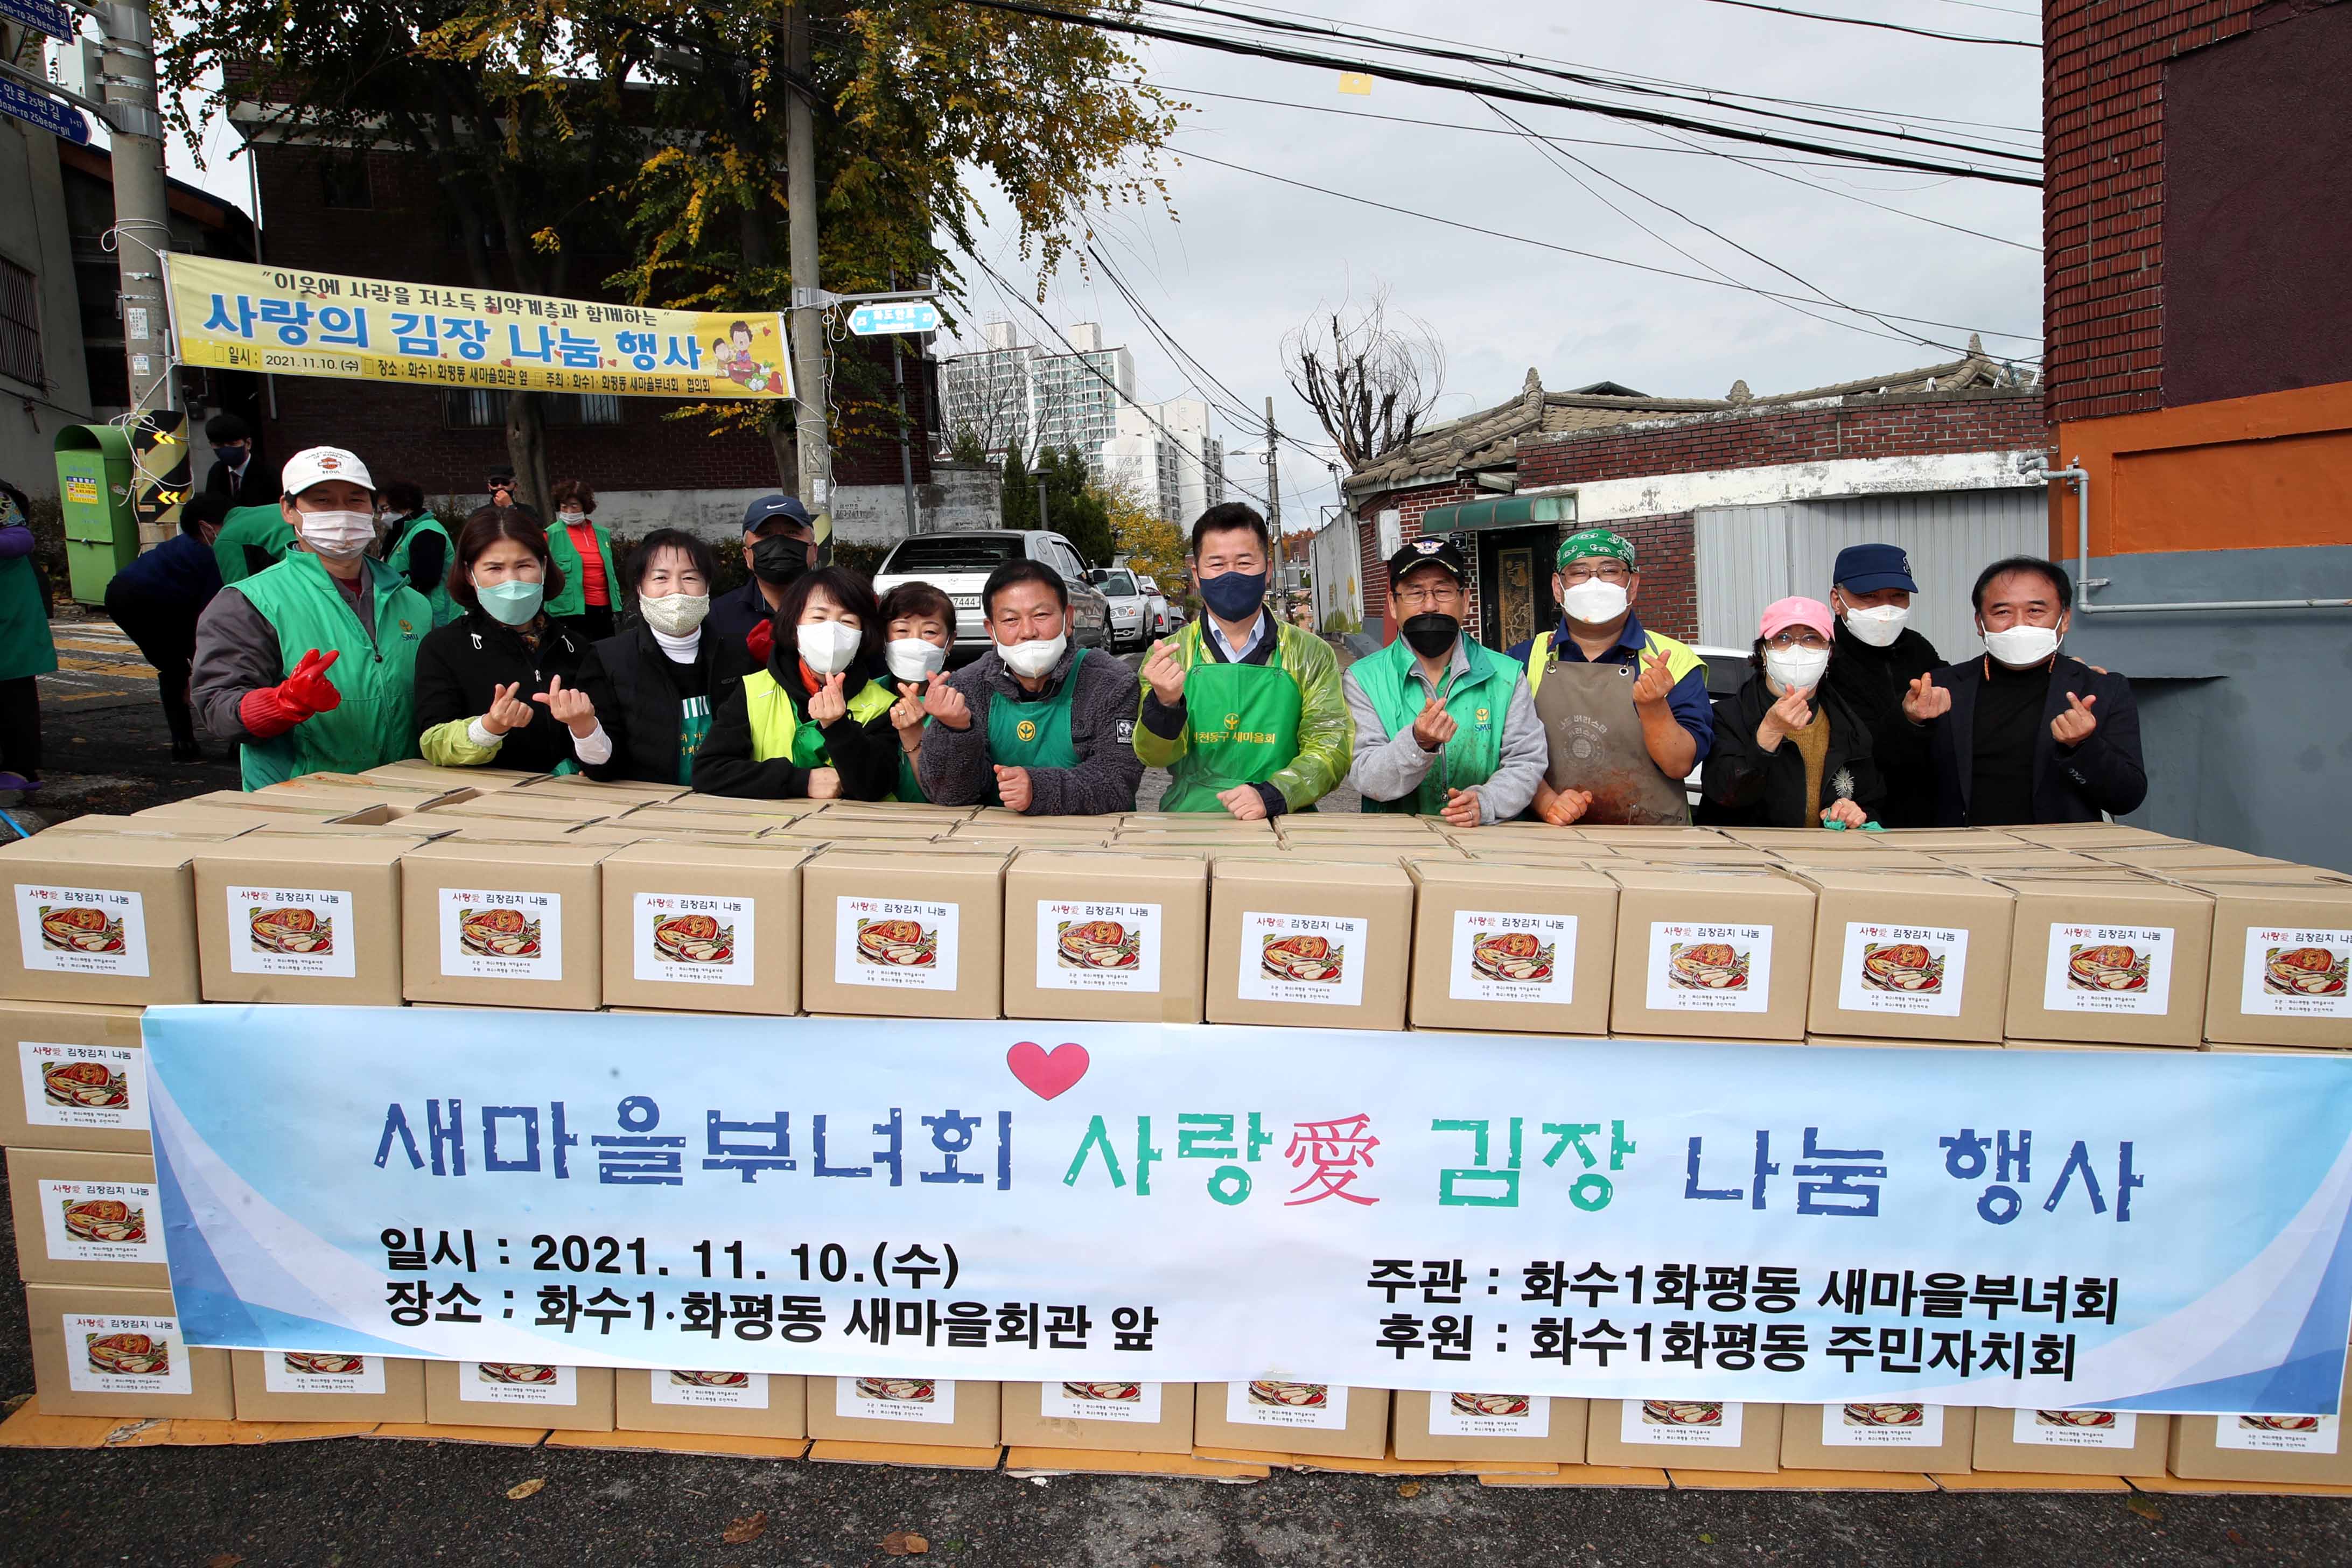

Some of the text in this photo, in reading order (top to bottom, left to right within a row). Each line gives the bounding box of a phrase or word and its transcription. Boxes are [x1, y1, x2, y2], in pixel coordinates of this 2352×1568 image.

[27, 12, 70, 39] 26beon-gil
[0, 83, 60, 121] 안로25번길
[31, 111, 70, 136] 25beon-gil
[350, 282, 411, 305] 사랑을
[418, 289, 476, 311] 저소득
[485, 296, 579, 319] 취약계층과
[586, 305, 656, 326] 함께하는
[204, 293, 702, 371] 사랑의 김장 나눔 행사
[229, 346, 250, 366] 일시
[379, 360, 397, 376] 장소
[470, 367, 515, 386] 새마을회관
[520, 370, 528, 386] 옆
[547, 373, 563, 388] 주최
[954, 598, 975, 606] 7444
[1475, 724, 1491, 732] SMU
[1233, 732, 1276, 745] 새마을회
[65, 892, 103, 903] 김장김치
[110, 895, 129, 904] 나눔
[276, 892, 314, 902] 김장김치
[320, 894, 339, 904] 나눔
[486, 894, 523, 905] 김장김치
[530, 896, 547, 905] 나눔
[681, 900, 717, 910] 김장김치
[724, 902, 741, 911] 나눔
[885, 904, 921, 914] 김장김치
[928, 907, 946, 916] 나눔
[1086, 906, 1123, 916] 김장김치
[1130, 908, 1148, 916] 나눔
[1291, 919, 1329, 930] 김장김치
[1335, 922, 1354, 932] 나눔
[1502, 918, 1539, 928] 김장김치
[1546, 920, 1564, 929] 나눔
[1698, 928, 1735, 937] 김장김치
[1741, 929, 1759, 938] 나눔
[1894, 929, 1931, 940] 김장김치
[1937, 932, 1955, 941] 나눔
[2098, 929, 2136, 939] 김장김치
[2143, 932, 2161, 941] 나눔
[2295, 933, 2334, 943] 김장김치
[67, 1048, 106, 1058] 김장김치
[112, 1051, 131, 1060] 나눔
[374, 1096, 1011, 1189] 새마을부녀회
[1432, 1117, 1636, 1212] 김장
[1685, 1128, 1887, 1216] 나눔
[1940, 1129, 2144, 1225] 행사
[86, 1185, 124, 1195] 김장김치
[130, 1187, 149, 1196] 나눔
[381, 1228, 476, 1272] 일시
[532, 1235, 668, 1275] 2021.
[694, 1241, 765, 1279] 11.
[1368, 1259, 1467, 1303] 주관
[1522, 1262, 1800, 1313] 화수1화평동
[1818, 1269, 2118, 1324] 새마을부녀회
[386, 1280, 481, 1326] 장소
[844, 1298, 1091, 1349] 새마을회관
[1112, 1307, 1158, 1350] 앞
[111, 1320, 149, 1328] 김장김치
[1377, 1314, 1472, 1361] 후원
[1531, 1318, 1808, 1371] 화수1화평동
[1826, 1322, 2075, 1381] 주민자치회
